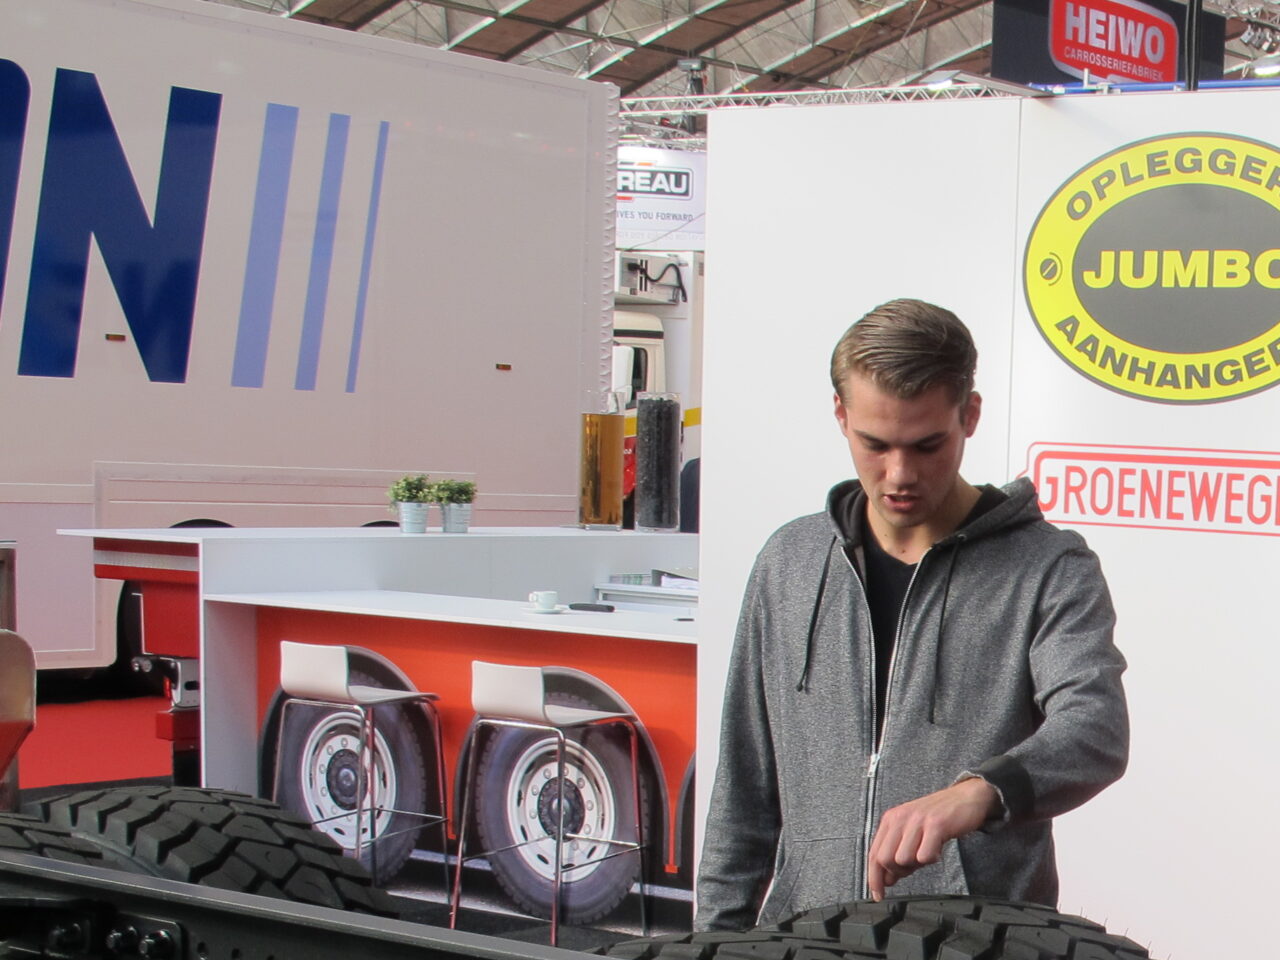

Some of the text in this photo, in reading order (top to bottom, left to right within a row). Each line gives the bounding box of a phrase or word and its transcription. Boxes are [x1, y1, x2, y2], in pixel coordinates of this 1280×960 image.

[1065, 2, 1165, 64] HEIWO
[1063, 46, 1164, 82] CARROSSERIEFABRIEK
[638, 211, 653, 220] YOU
[655, 212, 694, 222] FORWARD
